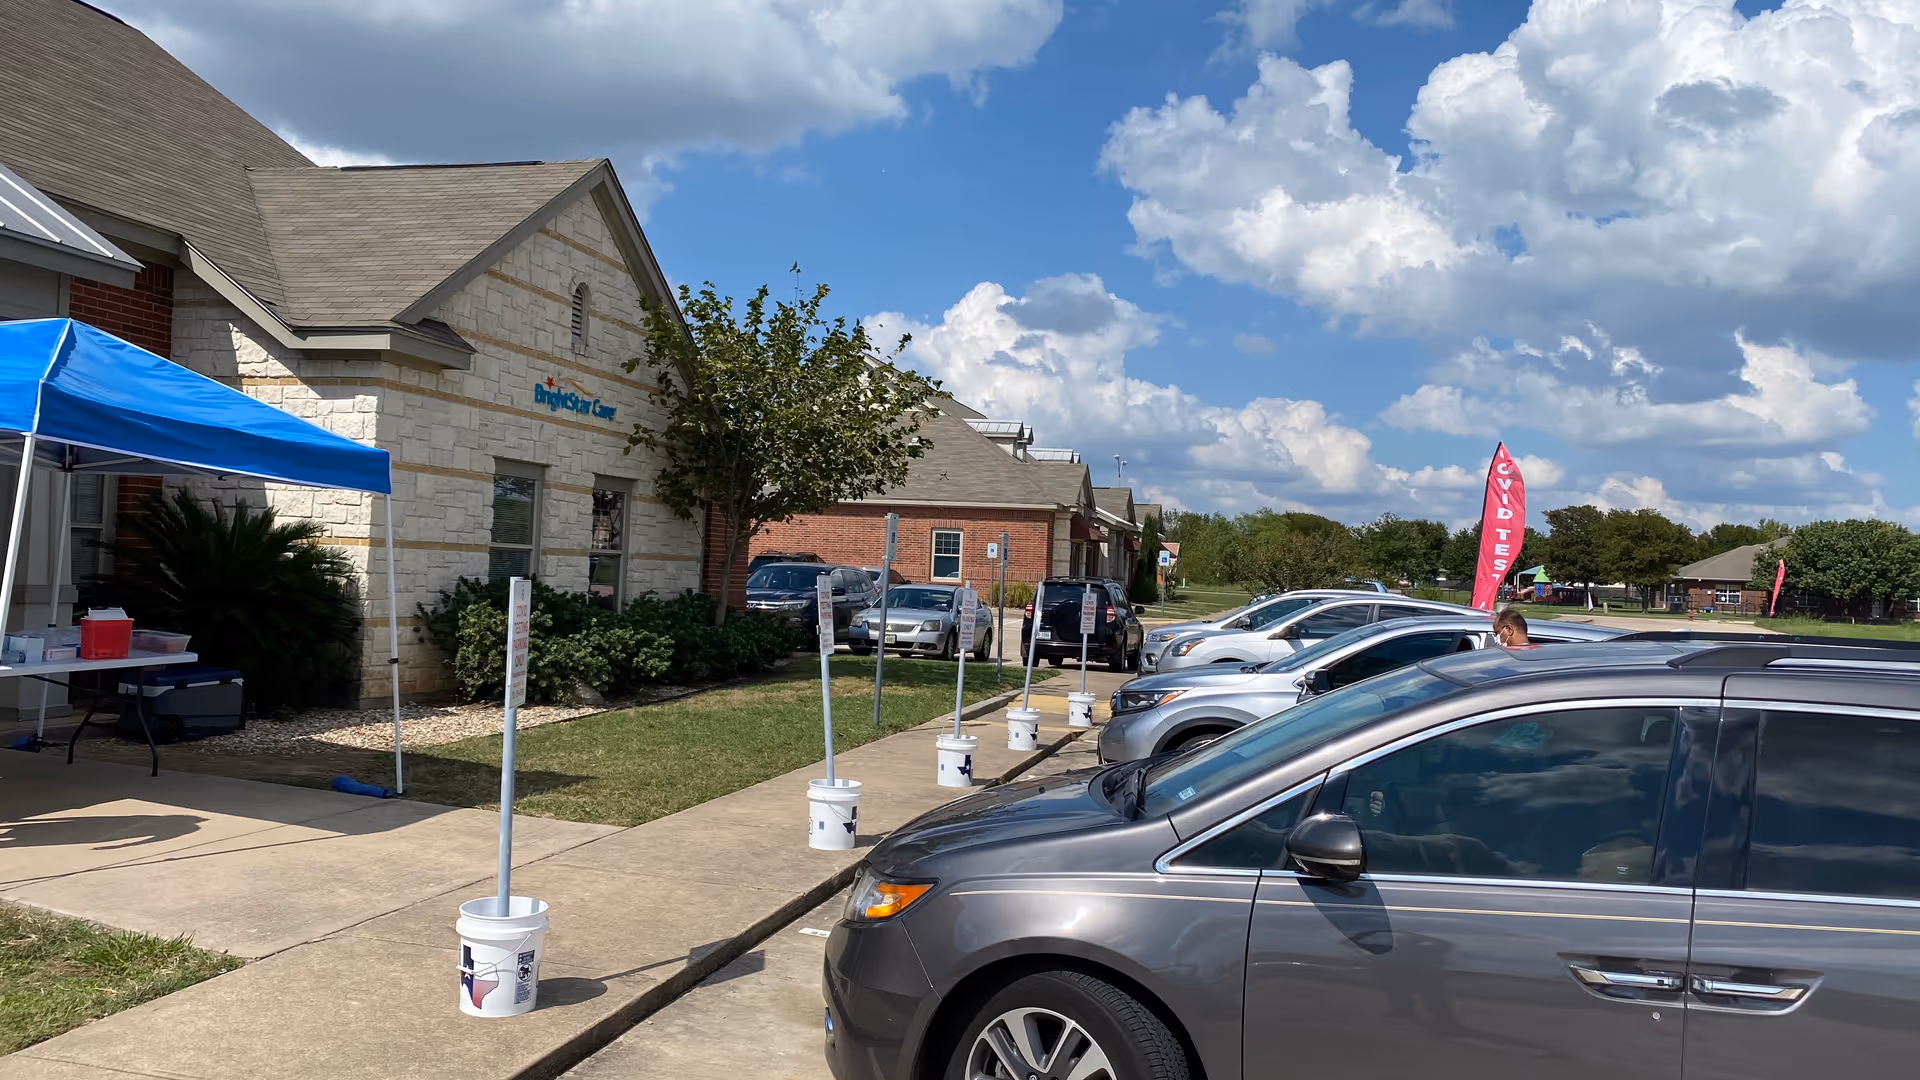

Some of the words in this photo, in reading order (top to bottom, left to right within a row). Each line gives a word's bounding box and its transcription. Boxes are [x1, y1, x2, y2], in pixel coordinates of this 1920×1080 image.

[535, 383, 591, 414] BrightStar
[592, 399, 616, 421] Care
[516, 604, 527, 617] COVID
